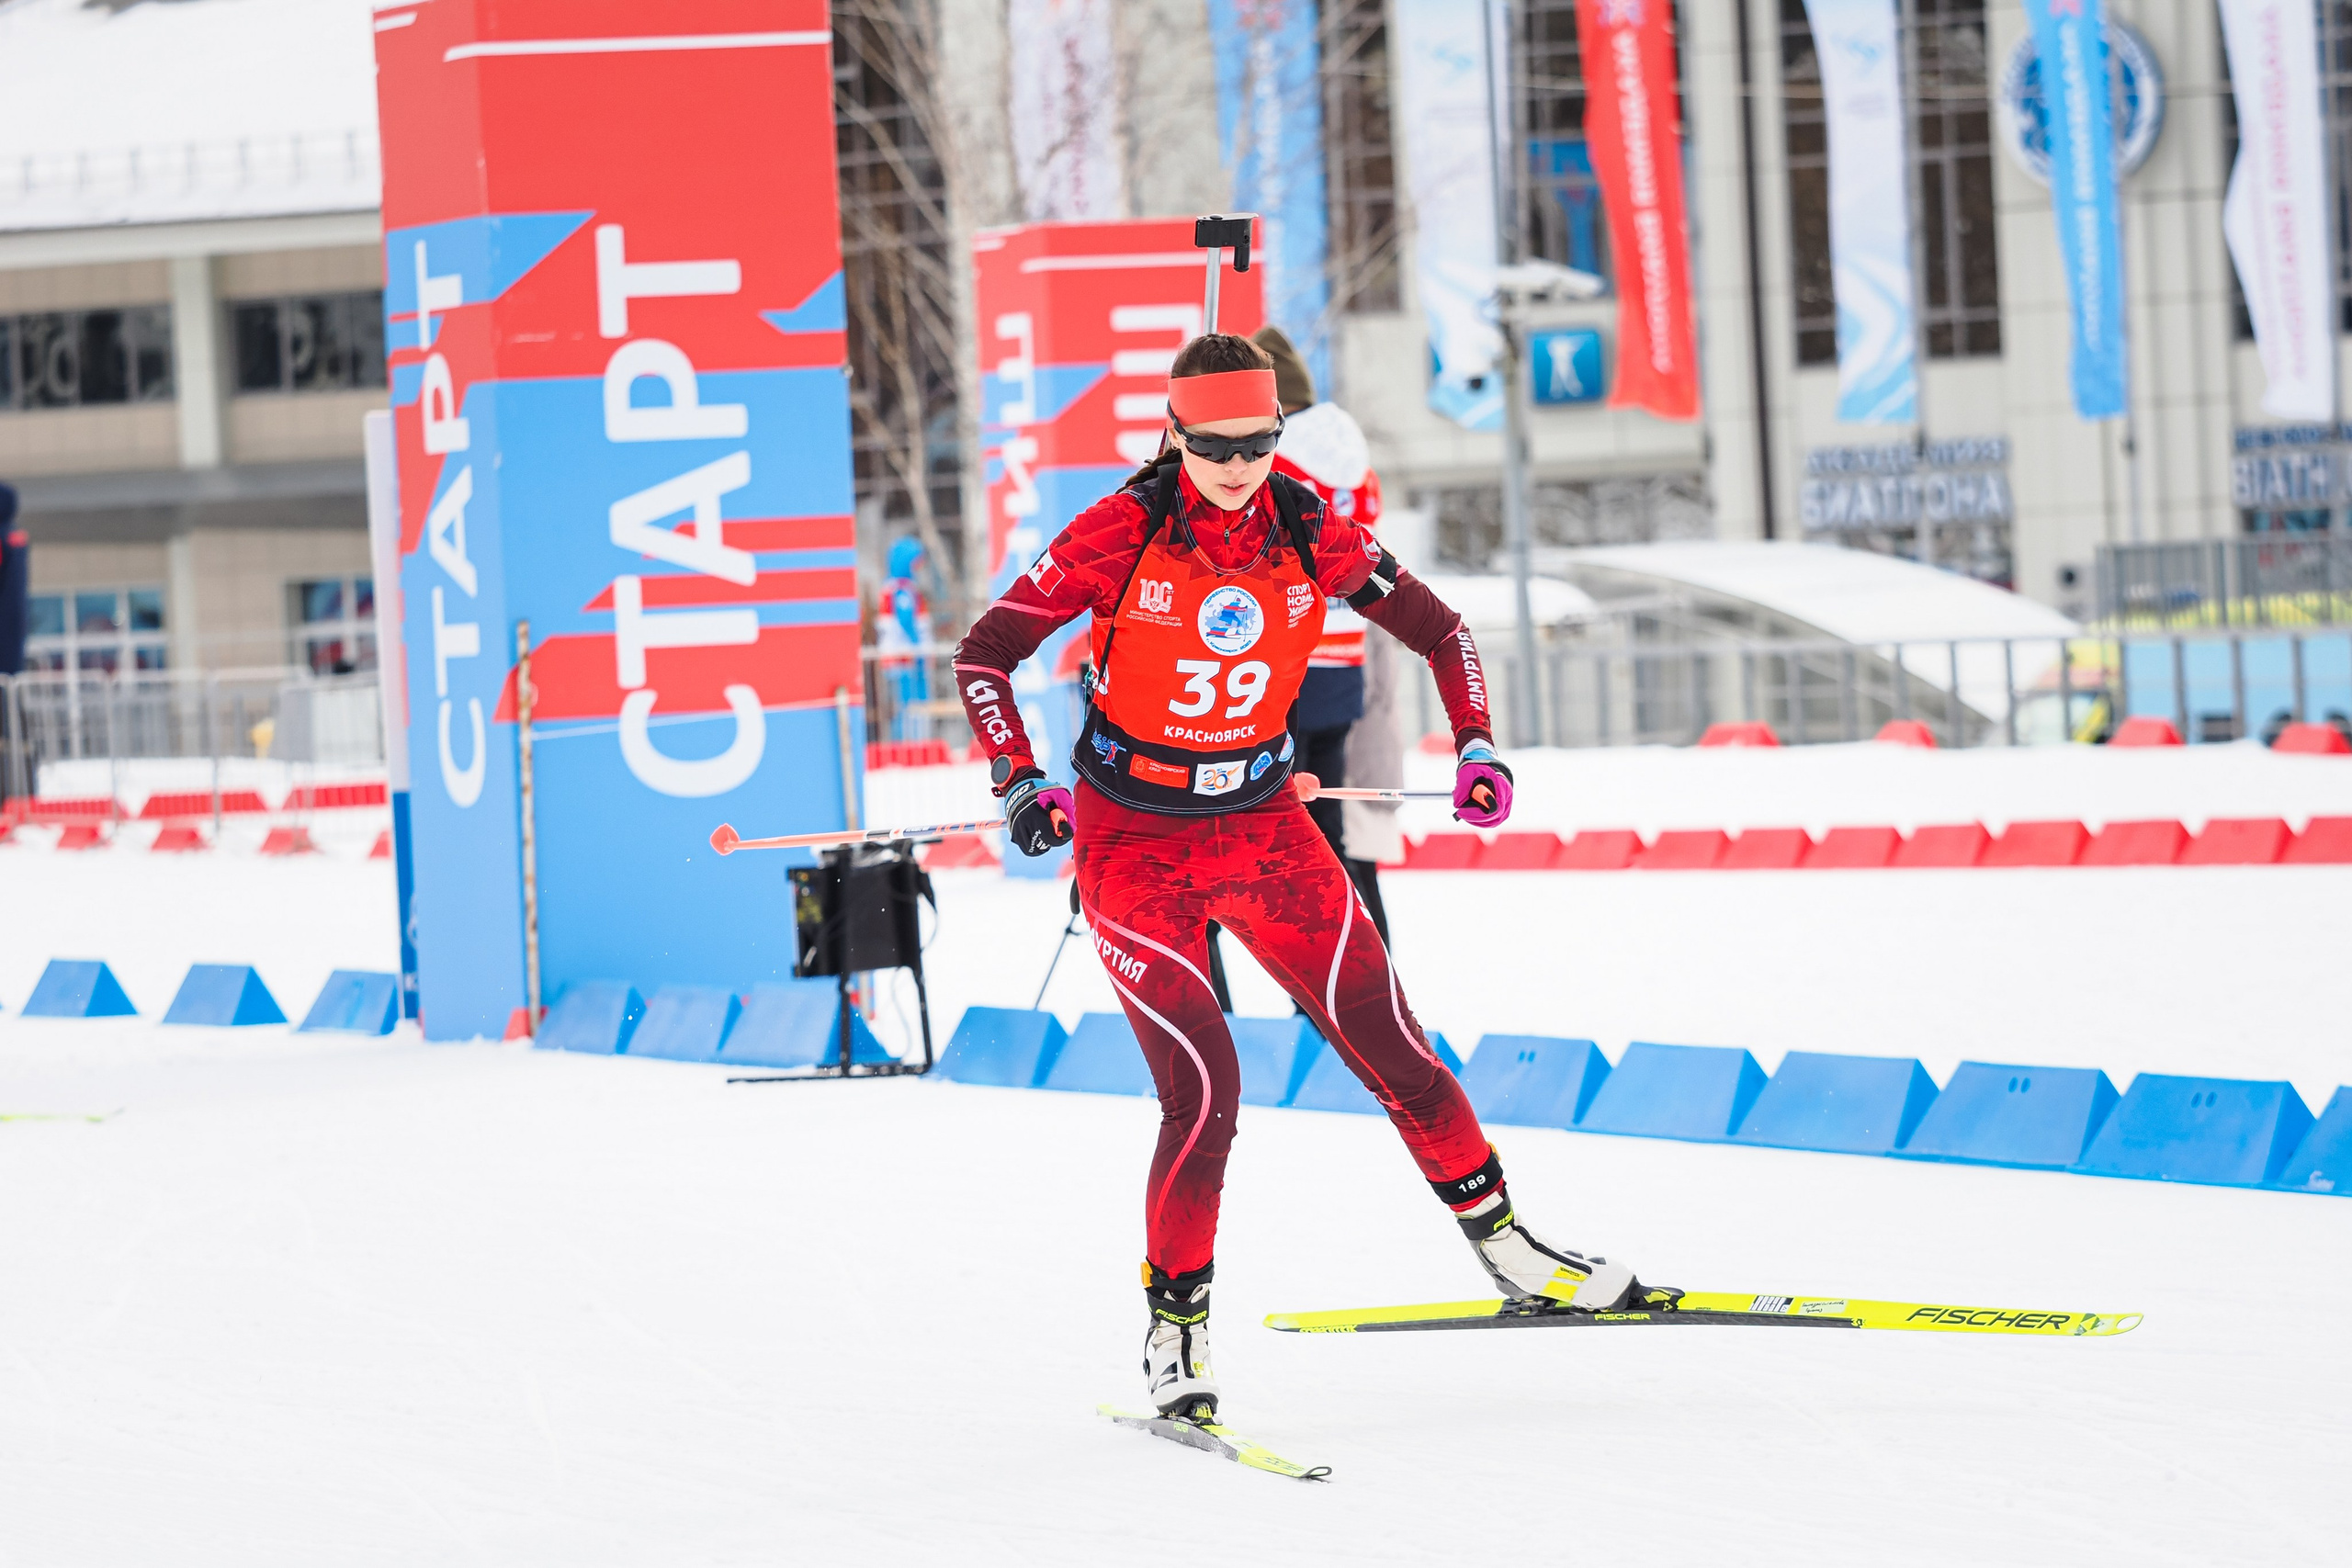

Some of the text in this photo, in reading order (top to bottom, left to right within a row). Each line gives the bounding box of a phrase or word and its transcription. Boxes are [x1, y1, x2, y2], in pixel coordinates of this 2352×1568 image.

[595, 224, 767, 797] СТАРТ
[415, 240, 486, 807] СТАРТ
[1204, 588, 1237, 606] ПЕРВЕНСТВО
[1286, 582, 1311, 596] СПОРТ
[1129, 610, 1163, 620] МИНИСТЕРСТВО
[1168, 659, 1272, 719] 39
[978, 705, 1012, 745] ПСБ
[1163, 724, 1257, 743] КРАСНОЯРСК
[1149, 761, 1186, 773] КРАСНОЯРСКИЙ
[1458, 1174, 1487, 1193] 189
[1156, 1308, 1207, 1325] FISCHER
[1594, 1313, 1651, 1321] FISCHER
[1905, 1307, 2071, 1330] FISCHER
